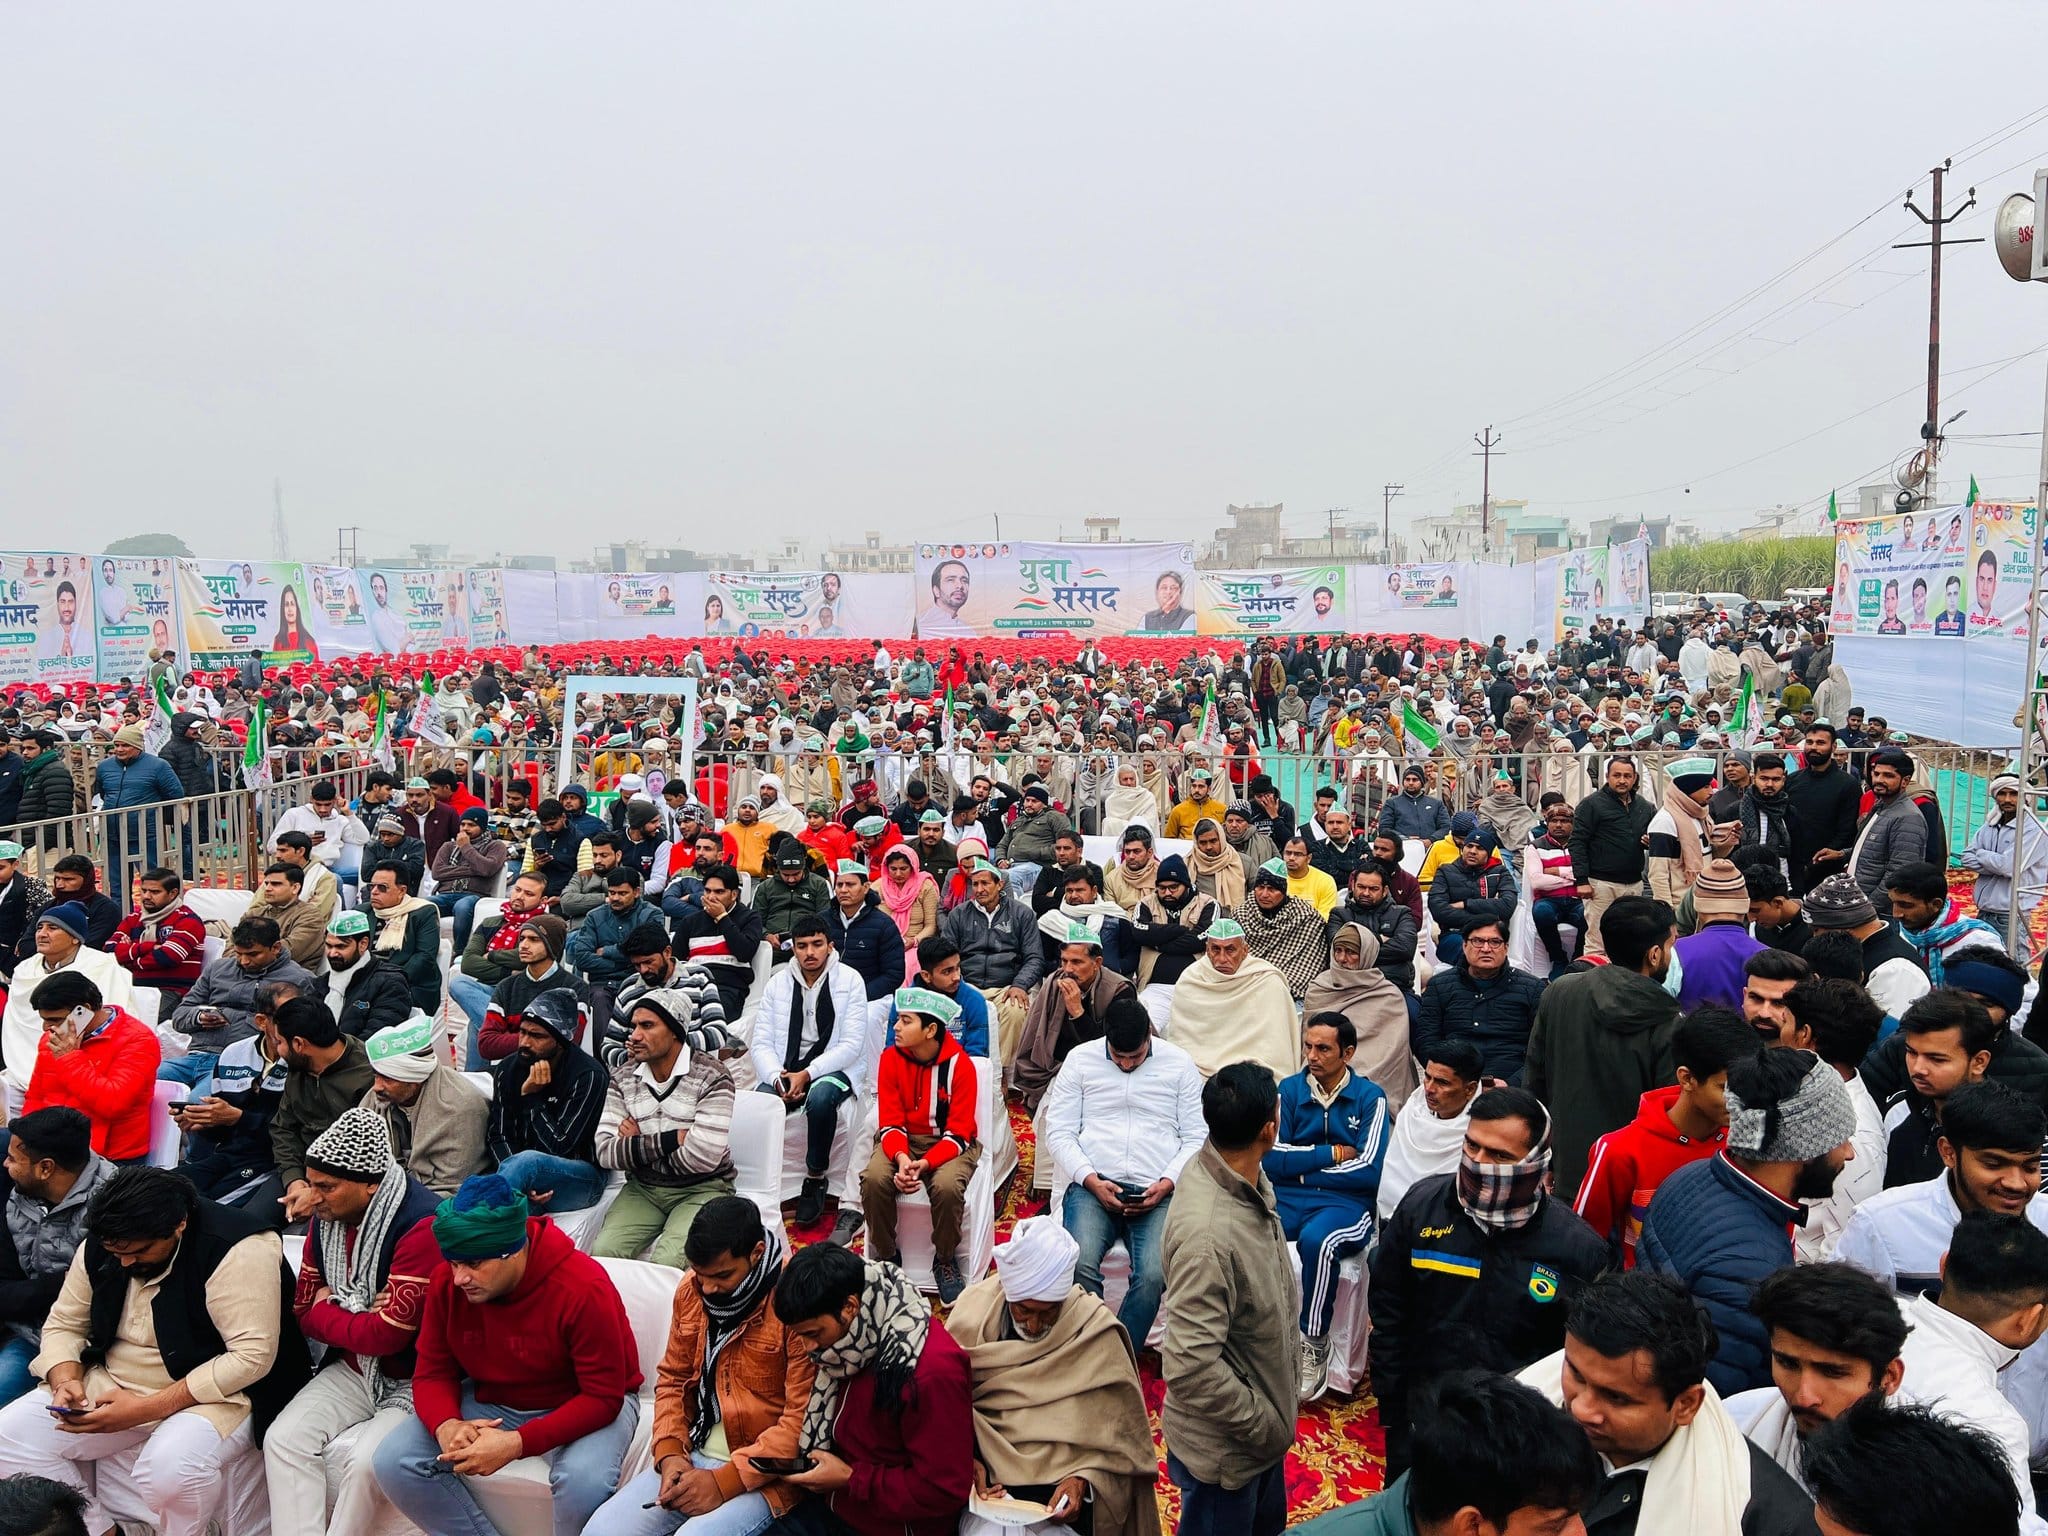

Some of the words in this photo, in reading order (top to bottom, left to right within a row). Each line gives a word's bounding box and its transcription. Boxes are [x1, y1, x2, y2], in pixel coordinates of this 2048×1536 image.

[2013, 552, 2027, 563] RLD
[1020, 560, 1072, 594] युवा
[133, 583, 152, 605] युवा
[202, 576, 237, 605] युवा
[406, 587, 426, 608] युवा
[1052, 582, 1120, 613] संसद
[1222, 583, 1263, 603] युवा
[144, 597, 169, 616] संसद
[222, 593, 268, 620] संसद
[418, 600, 443, 618] संसद
[730, 589, 763, 611] युवा
[763, 585, 808, 618] संसद
[1241, 593, 1298, 613] संसद
[38, 655, 67, 672] कुलदीप
[1536, 1266, 1557, 1280] BRAZIL
